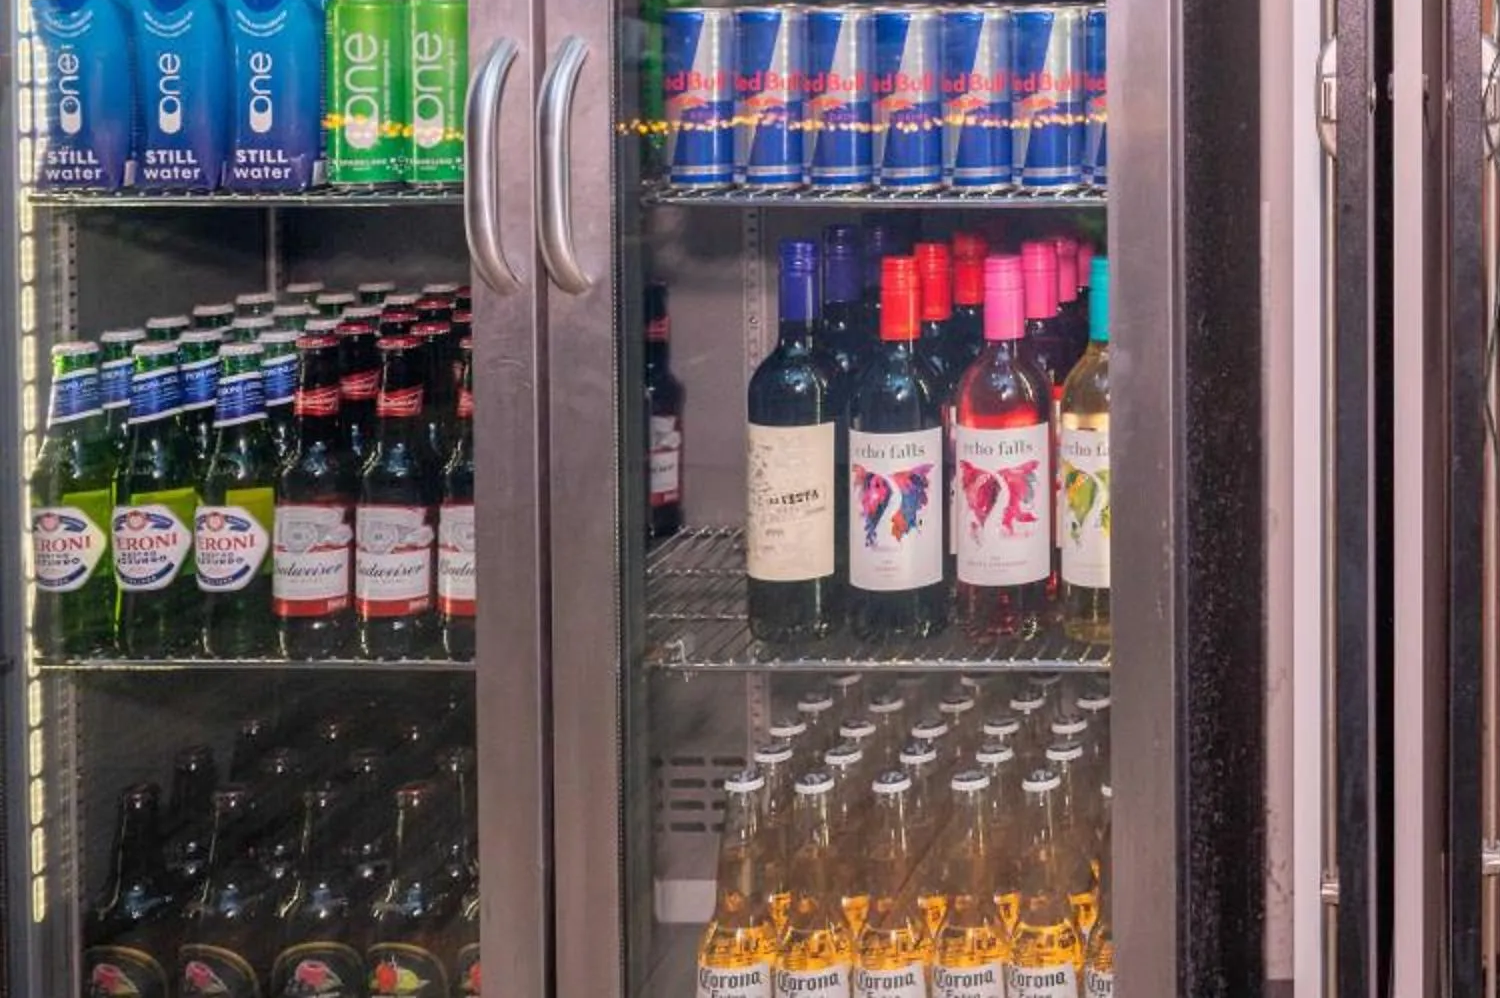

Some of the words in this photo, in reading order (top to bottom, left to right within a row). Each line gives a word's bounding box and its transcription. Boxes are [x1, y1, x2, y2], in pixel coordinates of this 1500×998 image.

[343, 29, 379, 149] one
[414, 30, 445, 149] one
[664, 71, 686, 91] ed
[687, 71, 725, 91] Bull
[735, 71, 761, 91] ed
[764, 71, 801, 91] Bull
[803, 71, 824, 92] ed
[826, 71, 864, 92] Bull
[872, 72, 893, 92] ed
[895, 72, 933, 92] Bull
[942, 72, 965, 92] ed
[969, 72, 1005, 92] Bull
[1012, 72, 1035, 92] ed
[1039, 72, 1080, 92] Bull
[158, 52, 181, 133] one
[249, 51, 272, 133] one
[46, 150, 98, 165] STILL
[145, 149, 197, 164] STILL
[235, 148, 288, 164] STILL
[45, 165, 102, 180] water
[143, 165, 201, 180] water
[233, 164, 291, 180] water
[889, 441, 926, 459] falls
[998, 439, 1034, 456] falls
[35, 536, 94, 554] ERONI
[121, 533, 185, 553] ERONI
[205, 534, 264, 553] ERONI
[273, 560, 344, 577] udweiser
[357, 560, 426, 578] udweiser
[699, 966, 762, 991] Corona
[776, 968, 839, 994] Corona
[858, 967, 914, 993] Corona
[933, 968, 994, 991] Corona
[1009, 969, 1066, 991] Corona
